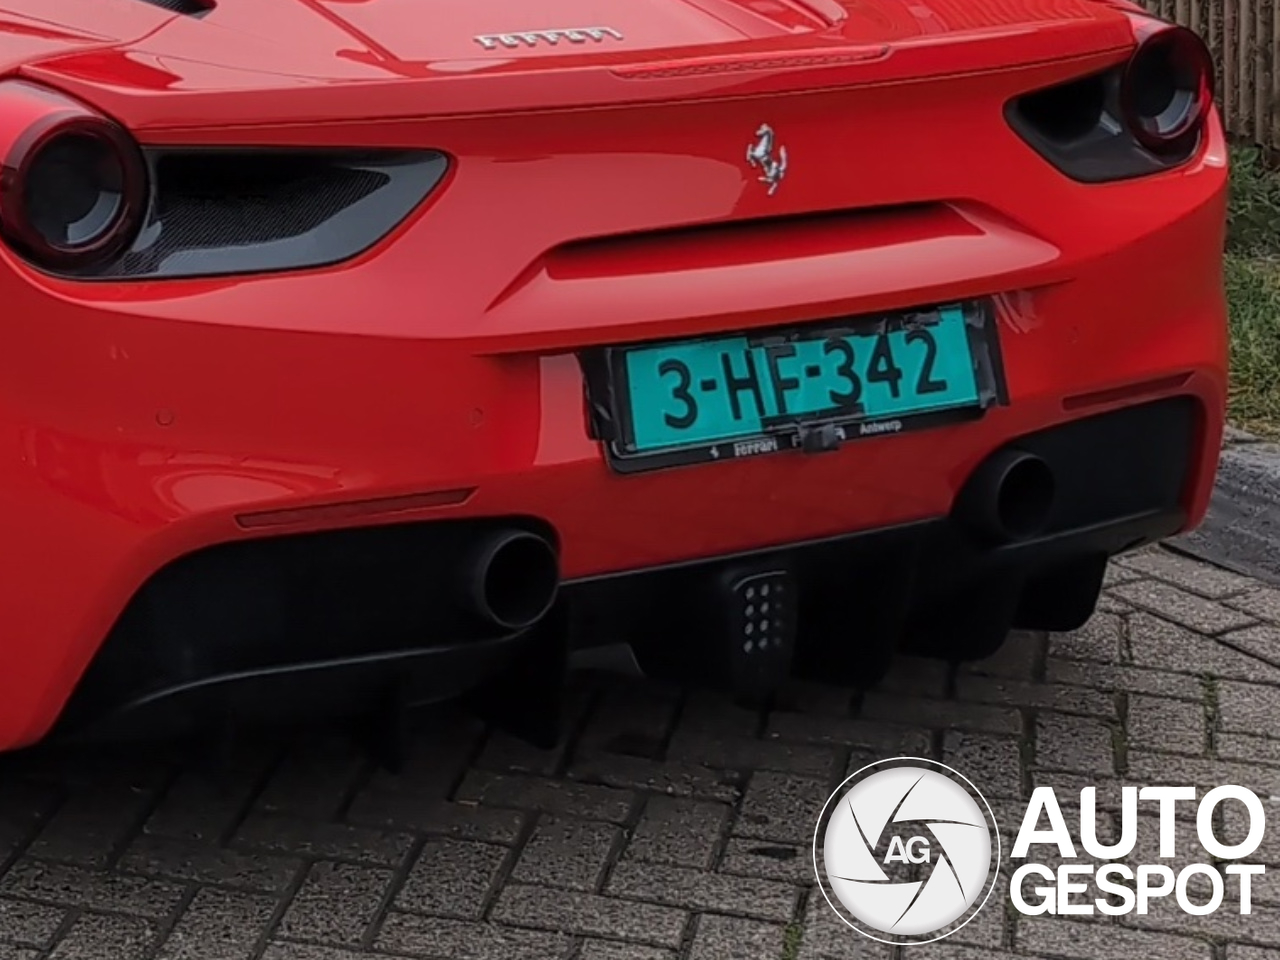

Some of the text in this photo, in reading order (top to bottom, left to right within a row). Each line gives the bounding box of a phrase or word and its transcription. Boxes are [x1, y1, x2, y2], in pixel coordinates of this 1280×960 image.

[657, 329, 947, 429] 3-HF-342
[733, 419, 902, 457] Ferrari Antwerp
